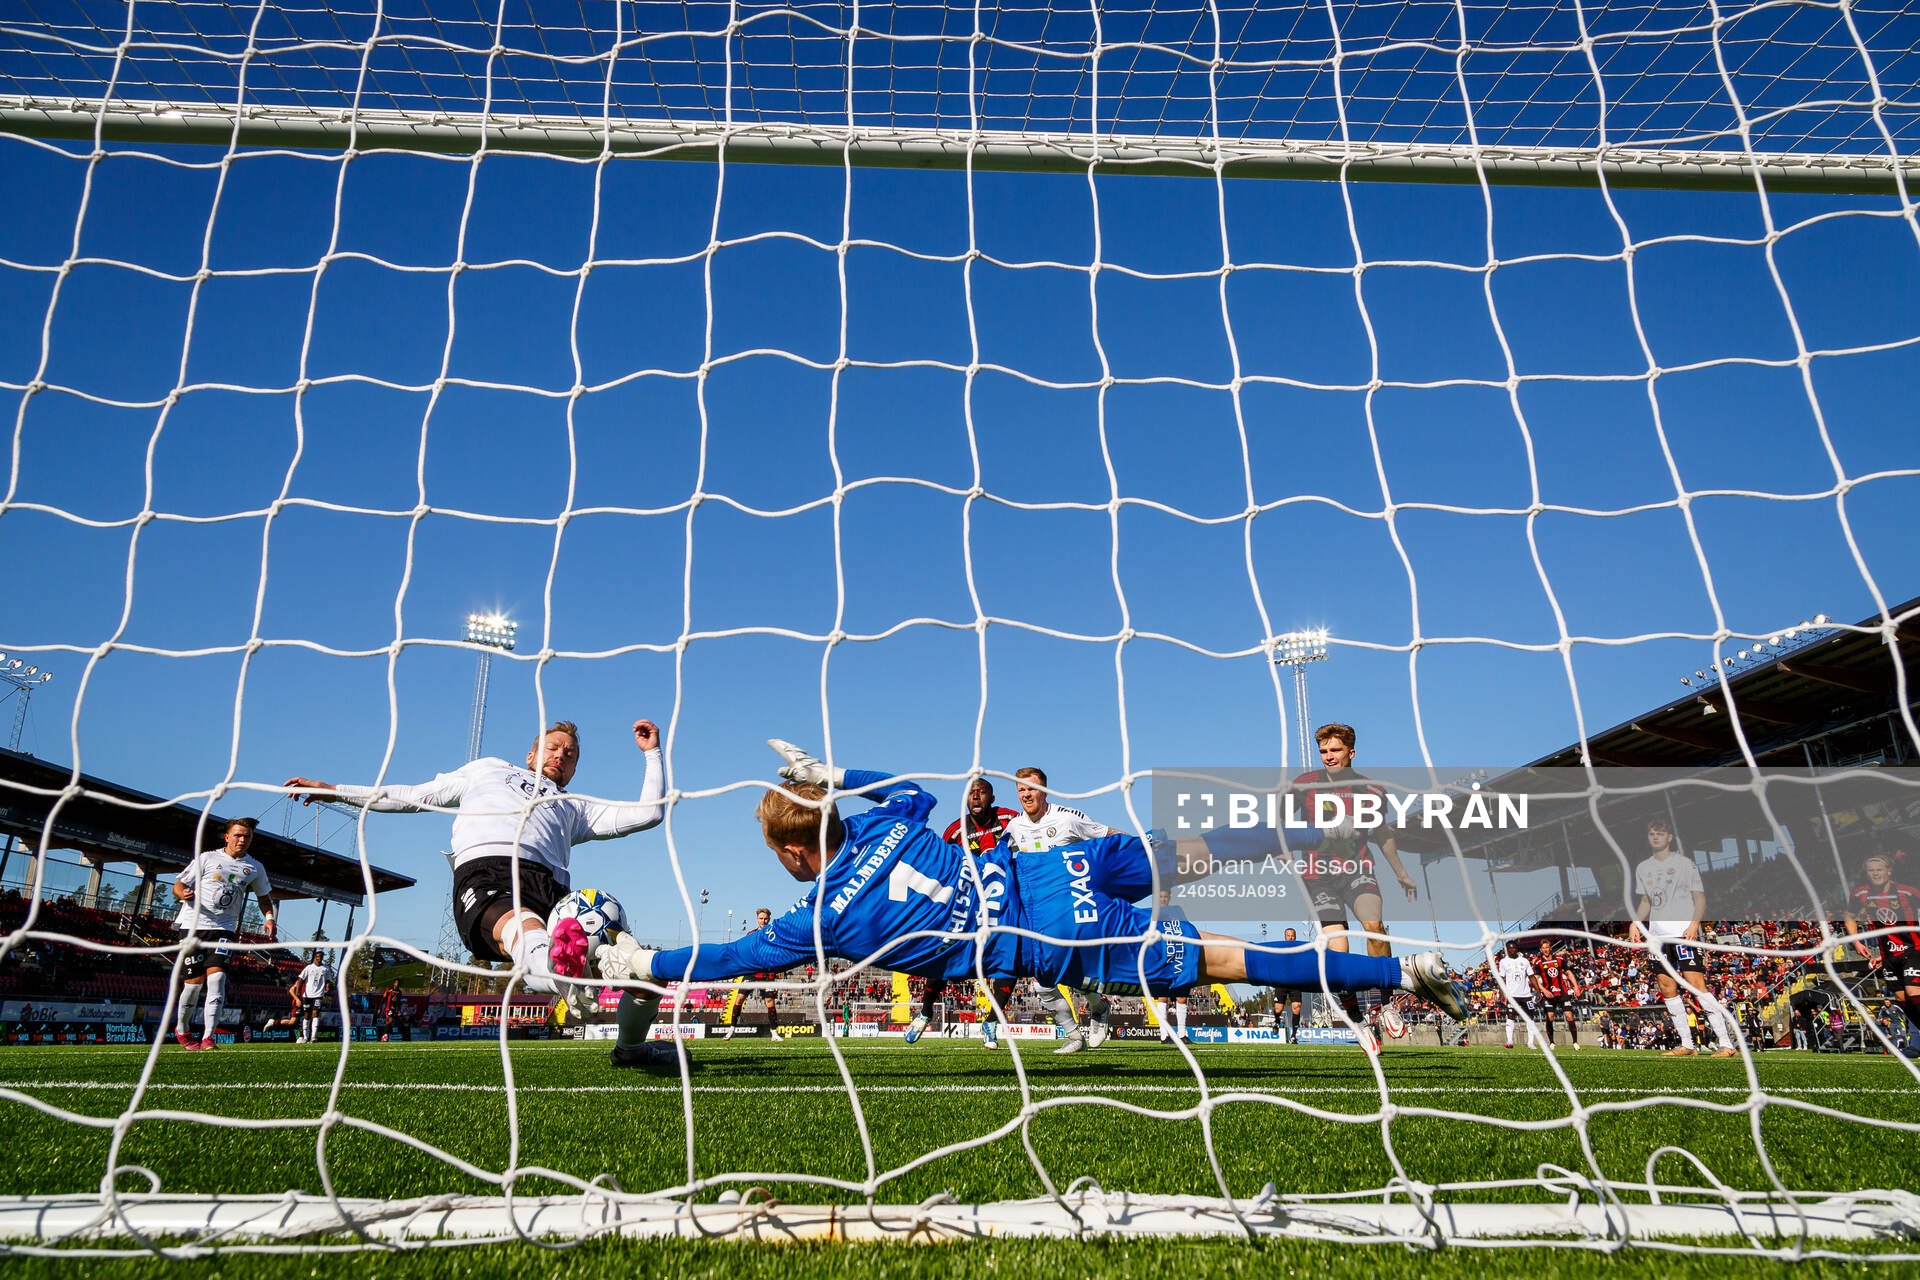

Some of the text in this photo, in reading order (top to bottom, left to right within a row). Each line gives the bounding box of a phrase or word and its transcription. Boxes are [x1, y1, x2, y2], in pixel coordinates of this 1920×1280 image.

[829, 822, 909, 915] MALMBERGS
[888, 860, 954, 905] 1
[1062, 851, 1098, 924] EXACT
[436, 1027, 501, 1037] POLARIS
[770, 1025, 814, 1034] ngcon
[1295, 1029, 1356, 1040] POLARIS
[106, 1033, 126, 1043] Brand
[126, 1033, 136, 1043] AB
[1246, 1030, 1280, 1040] INAB
